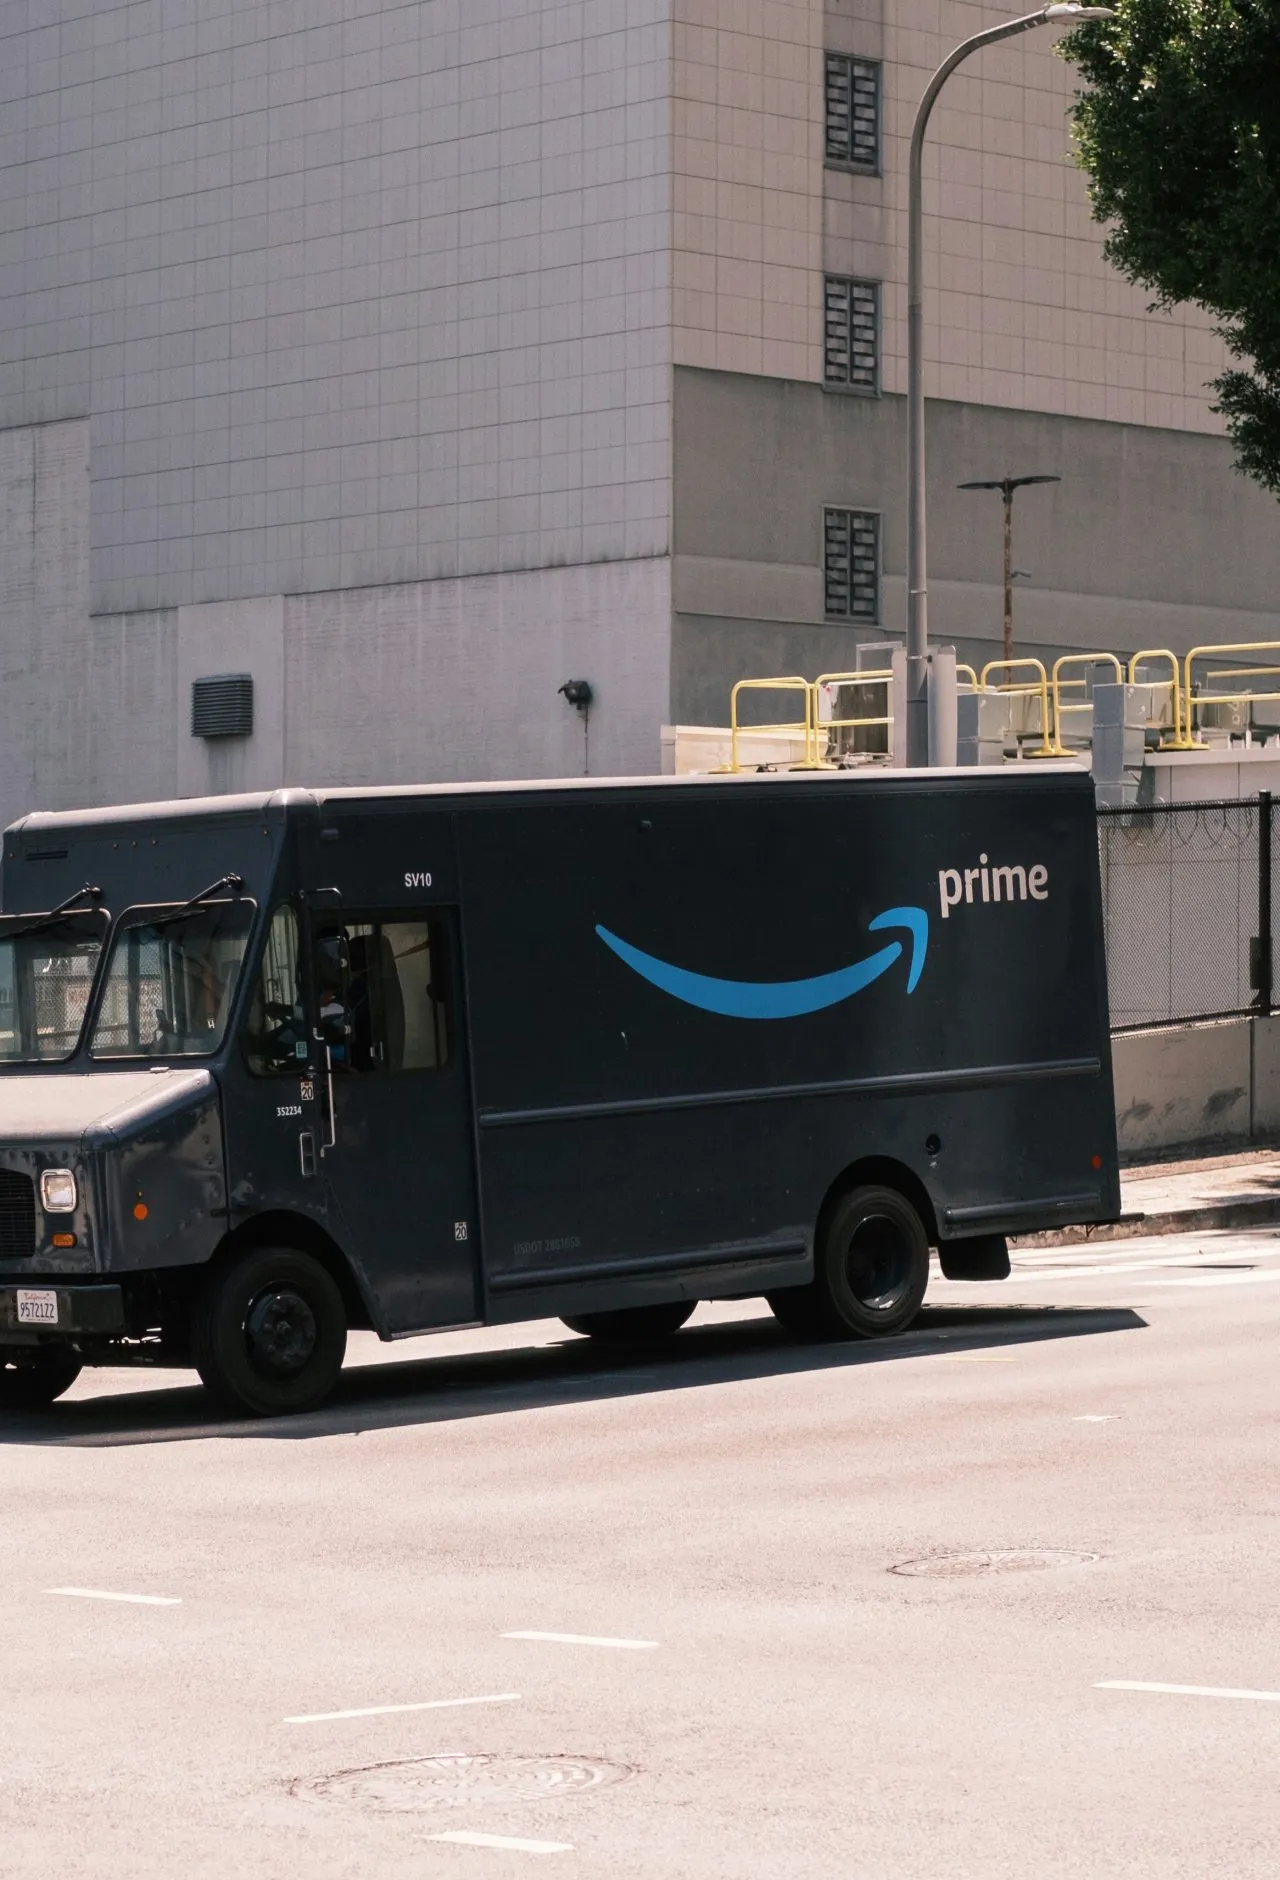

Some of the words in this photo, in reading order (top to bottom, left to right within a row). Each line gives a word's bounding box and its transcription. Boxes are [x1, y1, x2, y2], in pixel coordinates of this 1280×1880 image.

[404, 872, 432, 888] SV10
[938, 852, 1049, 919] prime
[302, 1086, 313, 1099] 20
[276, 1105, 302, 1117] 352234
[456, 1226, 467, 1239] 20
[513, 1240, 543, 1255] USDOT
